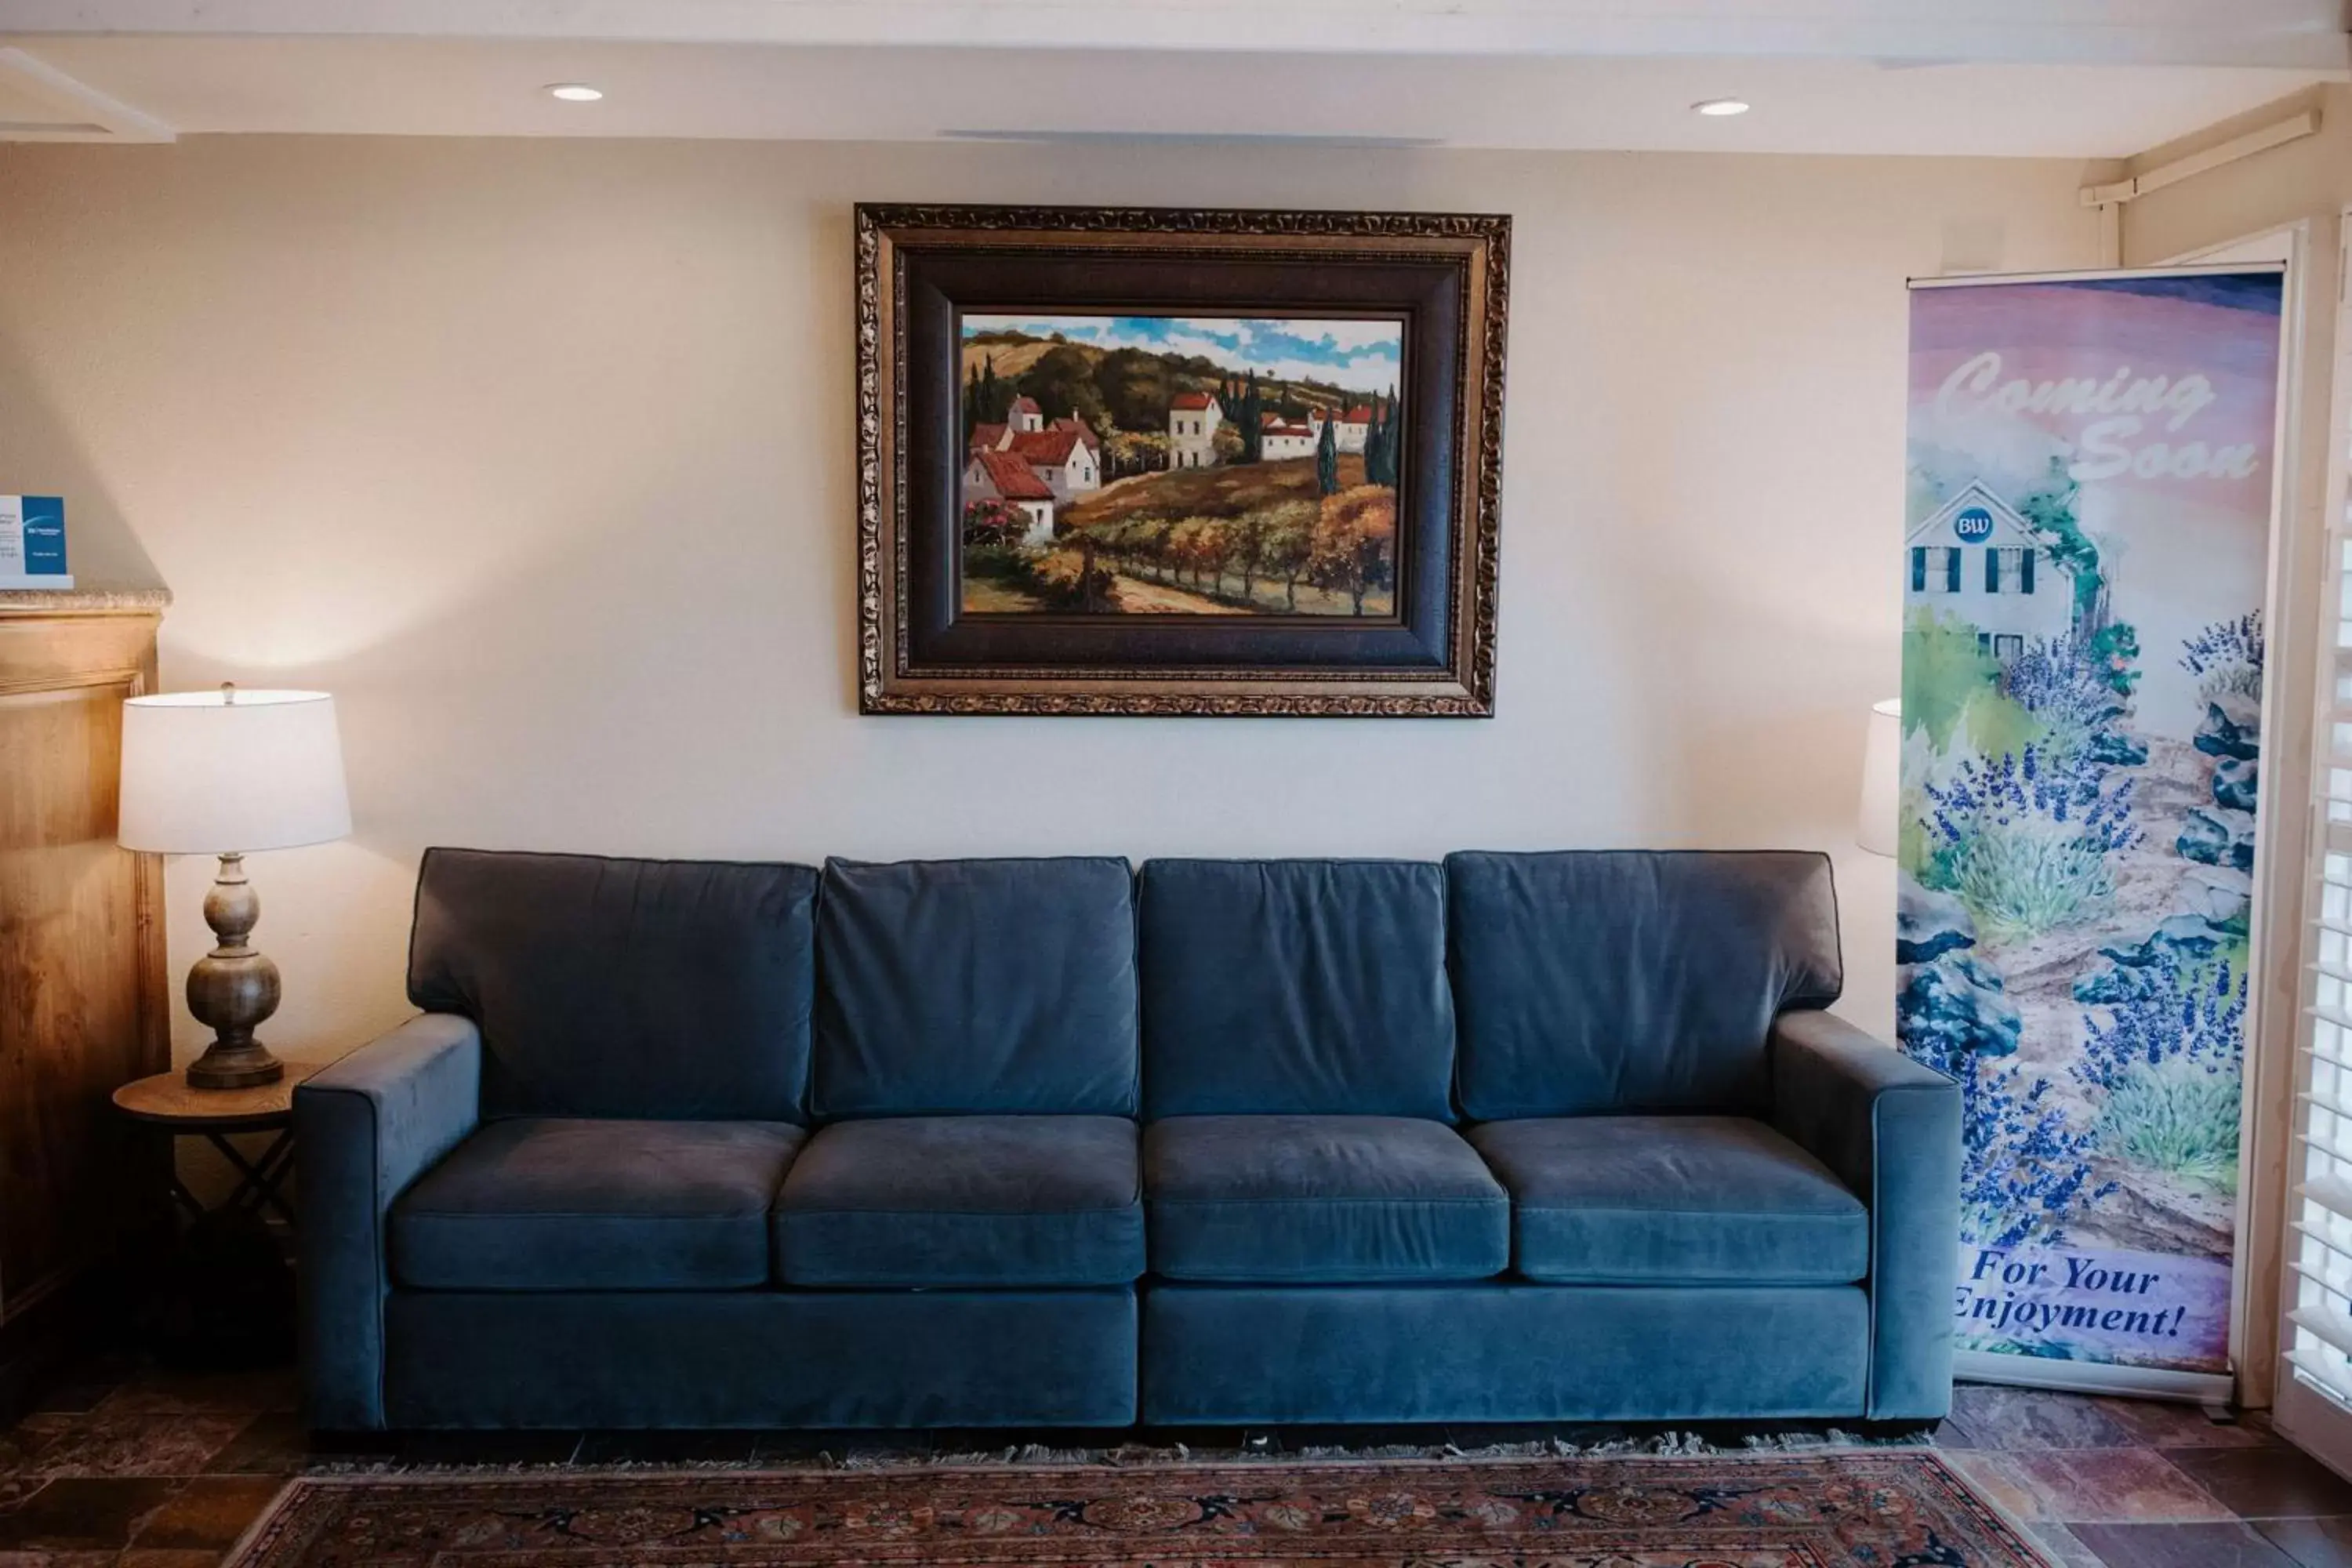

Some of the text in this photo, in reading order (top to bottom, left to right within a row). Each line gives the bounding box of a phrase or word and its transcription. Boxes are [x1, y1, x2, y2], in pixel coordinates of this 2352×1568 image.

[1933, 352, 2216, 432] Coming
[2068, 415, 2260, 481] Soon
[1958, 517, 1990, 534] BW
[1970, 1250, 2160, 1294] For Your
